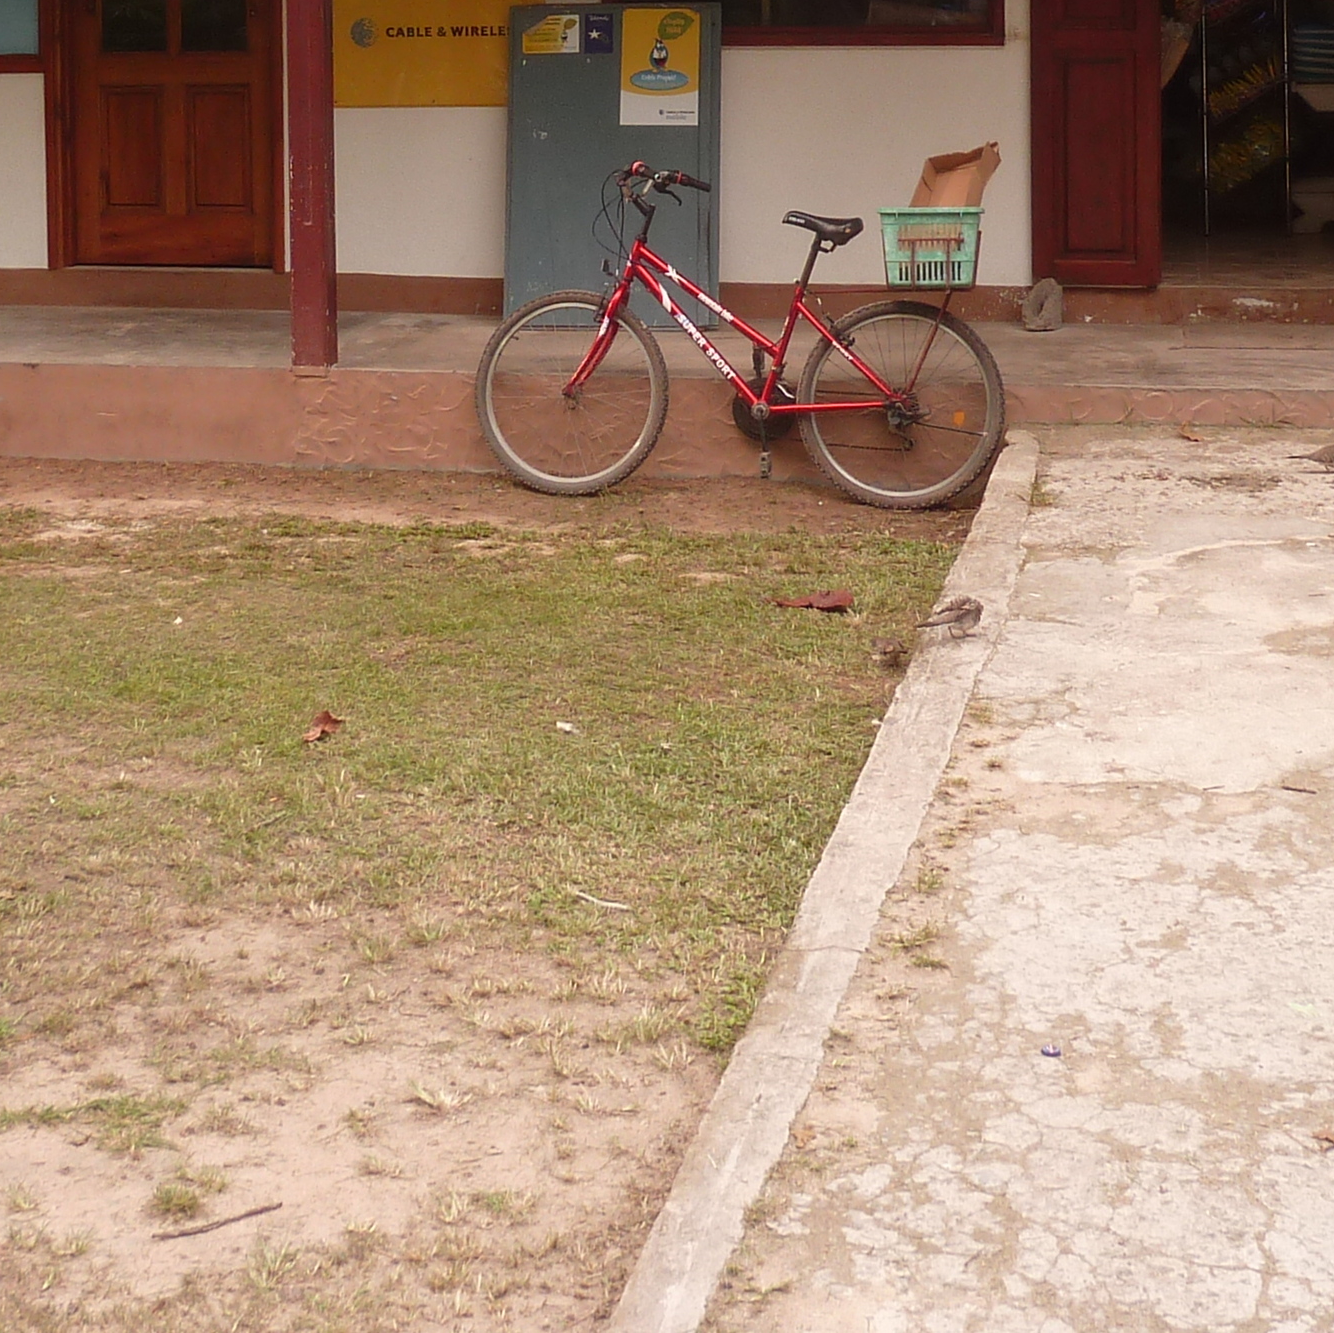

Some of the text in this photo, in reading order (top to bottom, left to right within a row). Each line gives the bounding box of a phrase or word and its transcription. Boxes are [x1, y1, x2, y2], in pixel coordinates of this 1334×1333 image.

[385, 26, 510, 38] CABLE & WIRELE
[673, 314, 737, 380] SUPER SPORT
